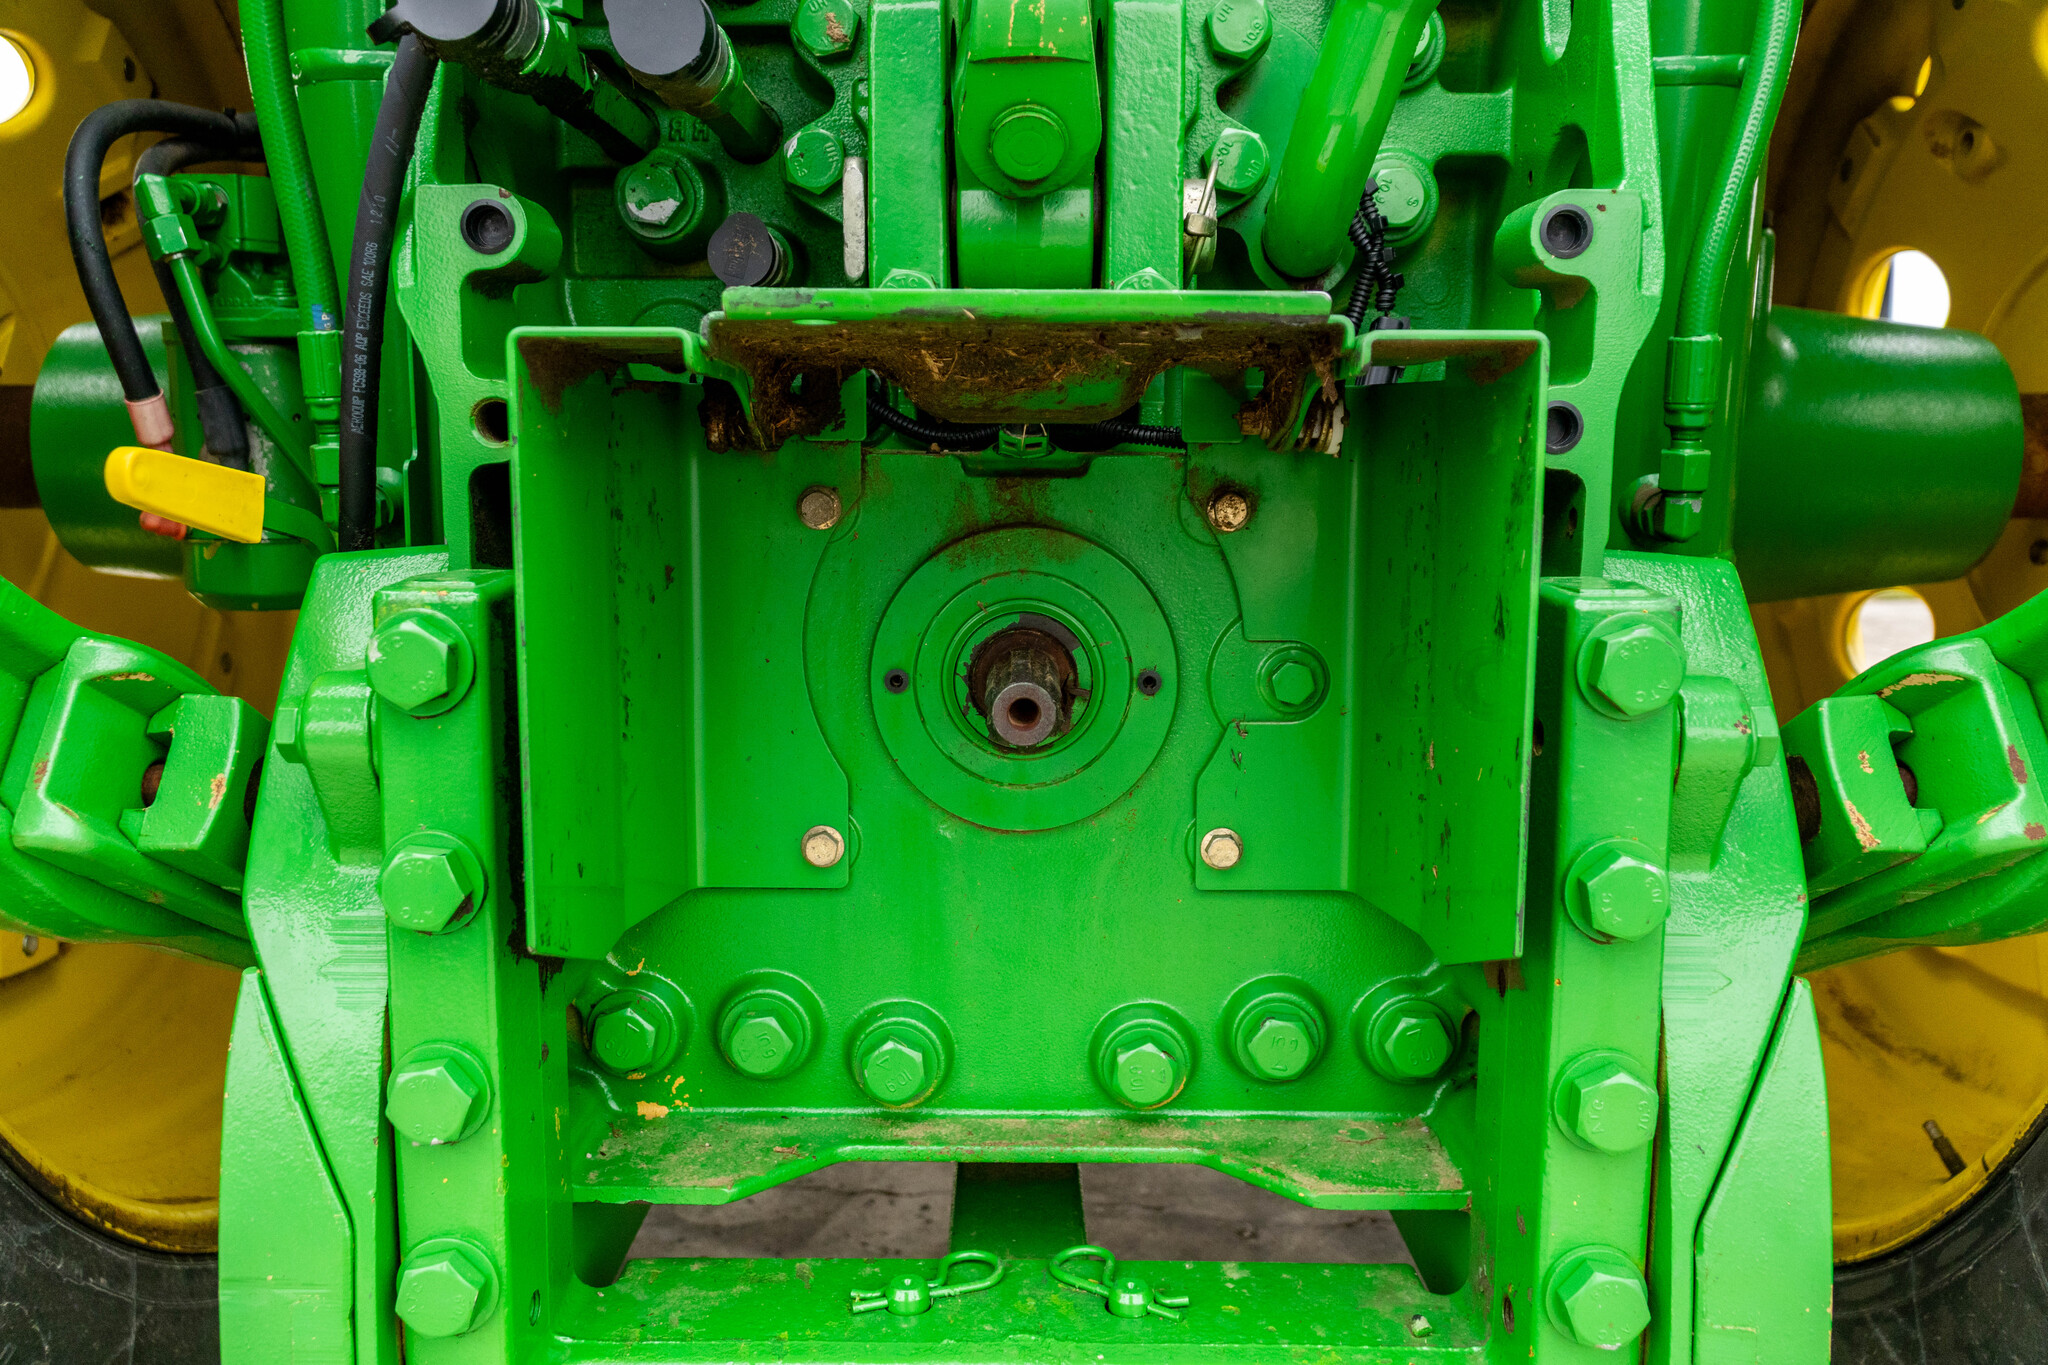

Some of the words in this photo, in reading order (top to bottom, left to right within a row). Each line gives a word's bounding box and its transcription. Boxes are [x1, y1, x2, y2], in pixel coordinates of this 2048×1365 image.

[1216, 3, 1234, 24] UH
[363, 241, 378, 266] 100R6
[361, 268, 375, 287] SAE
[356, 291, 372, 330] EXCEEDS
